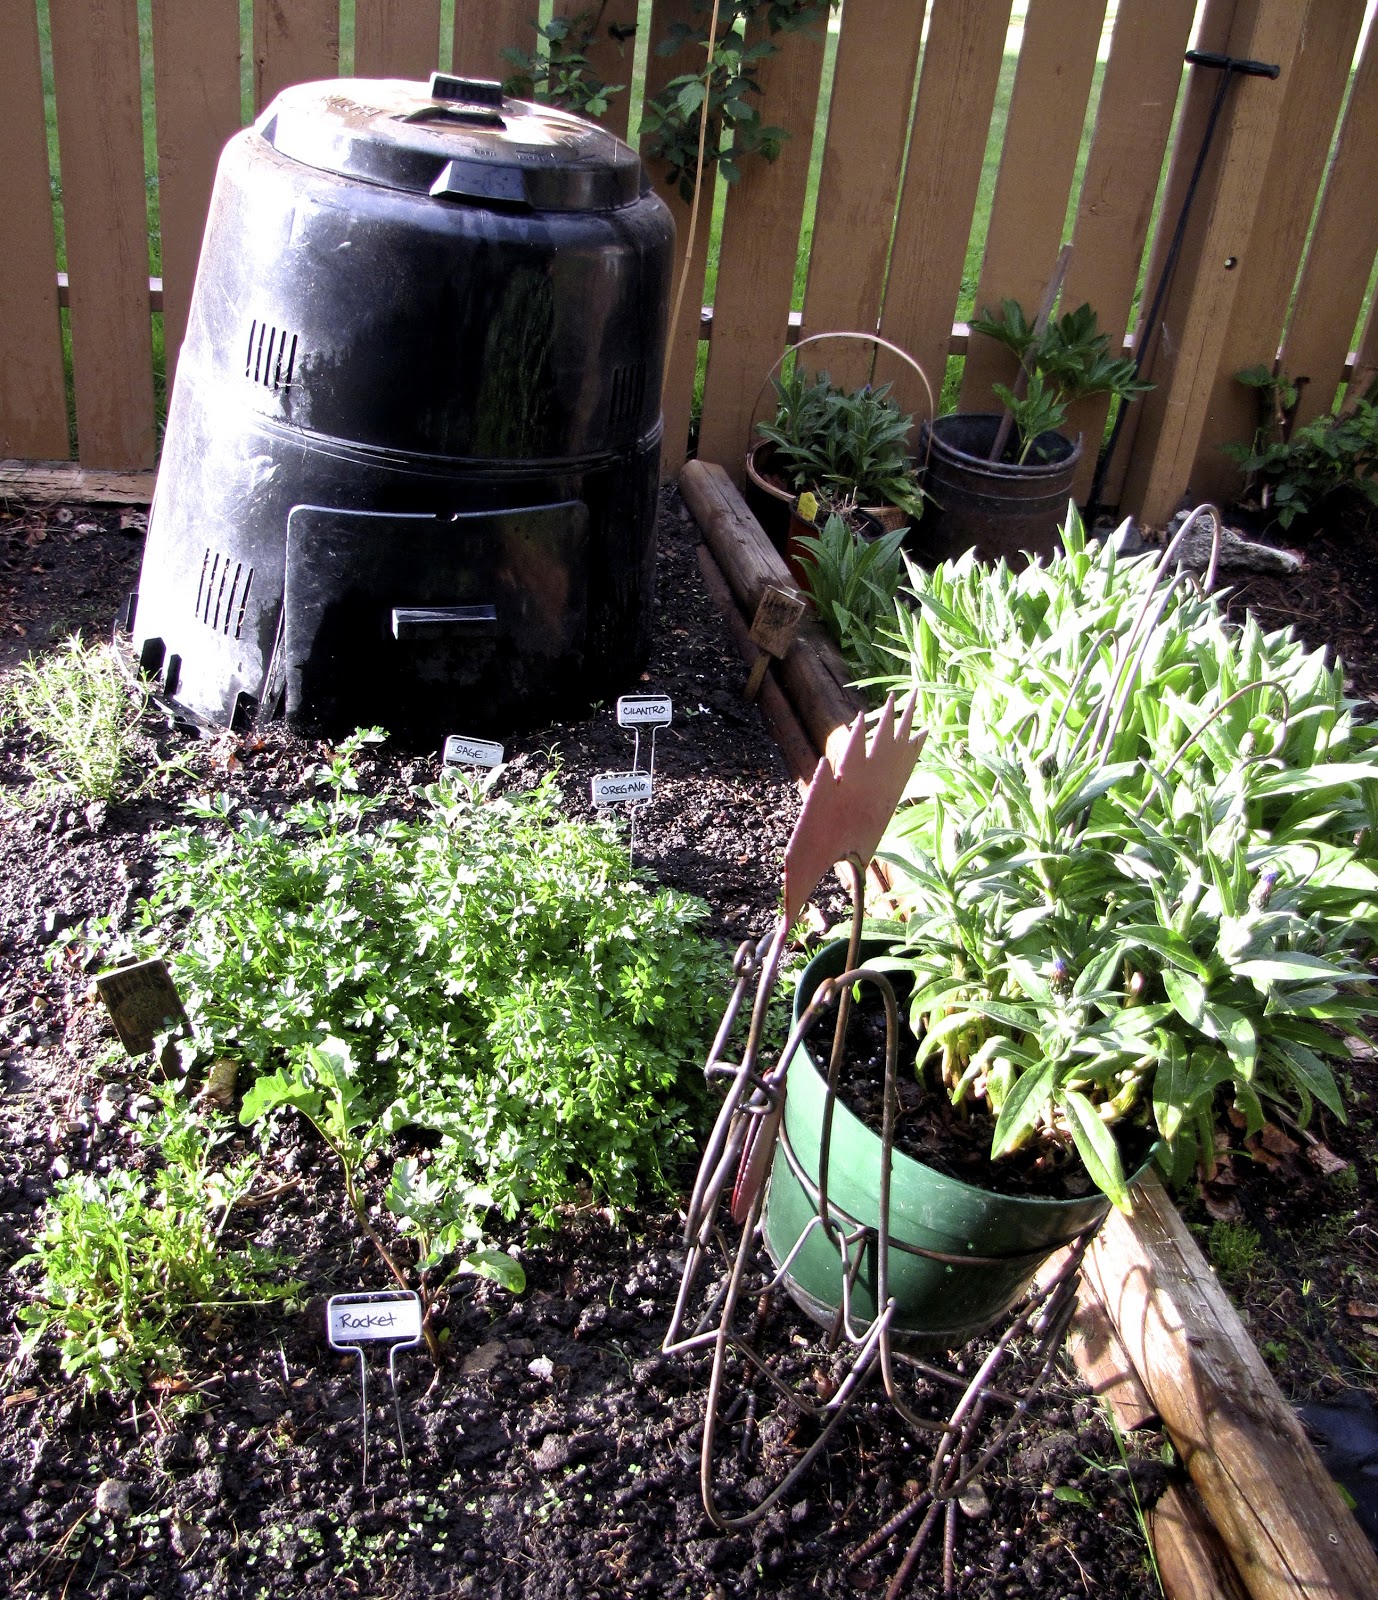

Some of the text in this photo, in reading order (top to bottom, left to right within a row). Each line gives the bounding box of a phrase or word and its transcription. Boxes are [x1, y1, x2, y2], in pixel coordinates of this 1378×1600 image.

[623, 705, 666, 716] CILANTRO
[600, 781, 646, 795] OREGANO
[339, 1312, 397, 1328] Rocket
